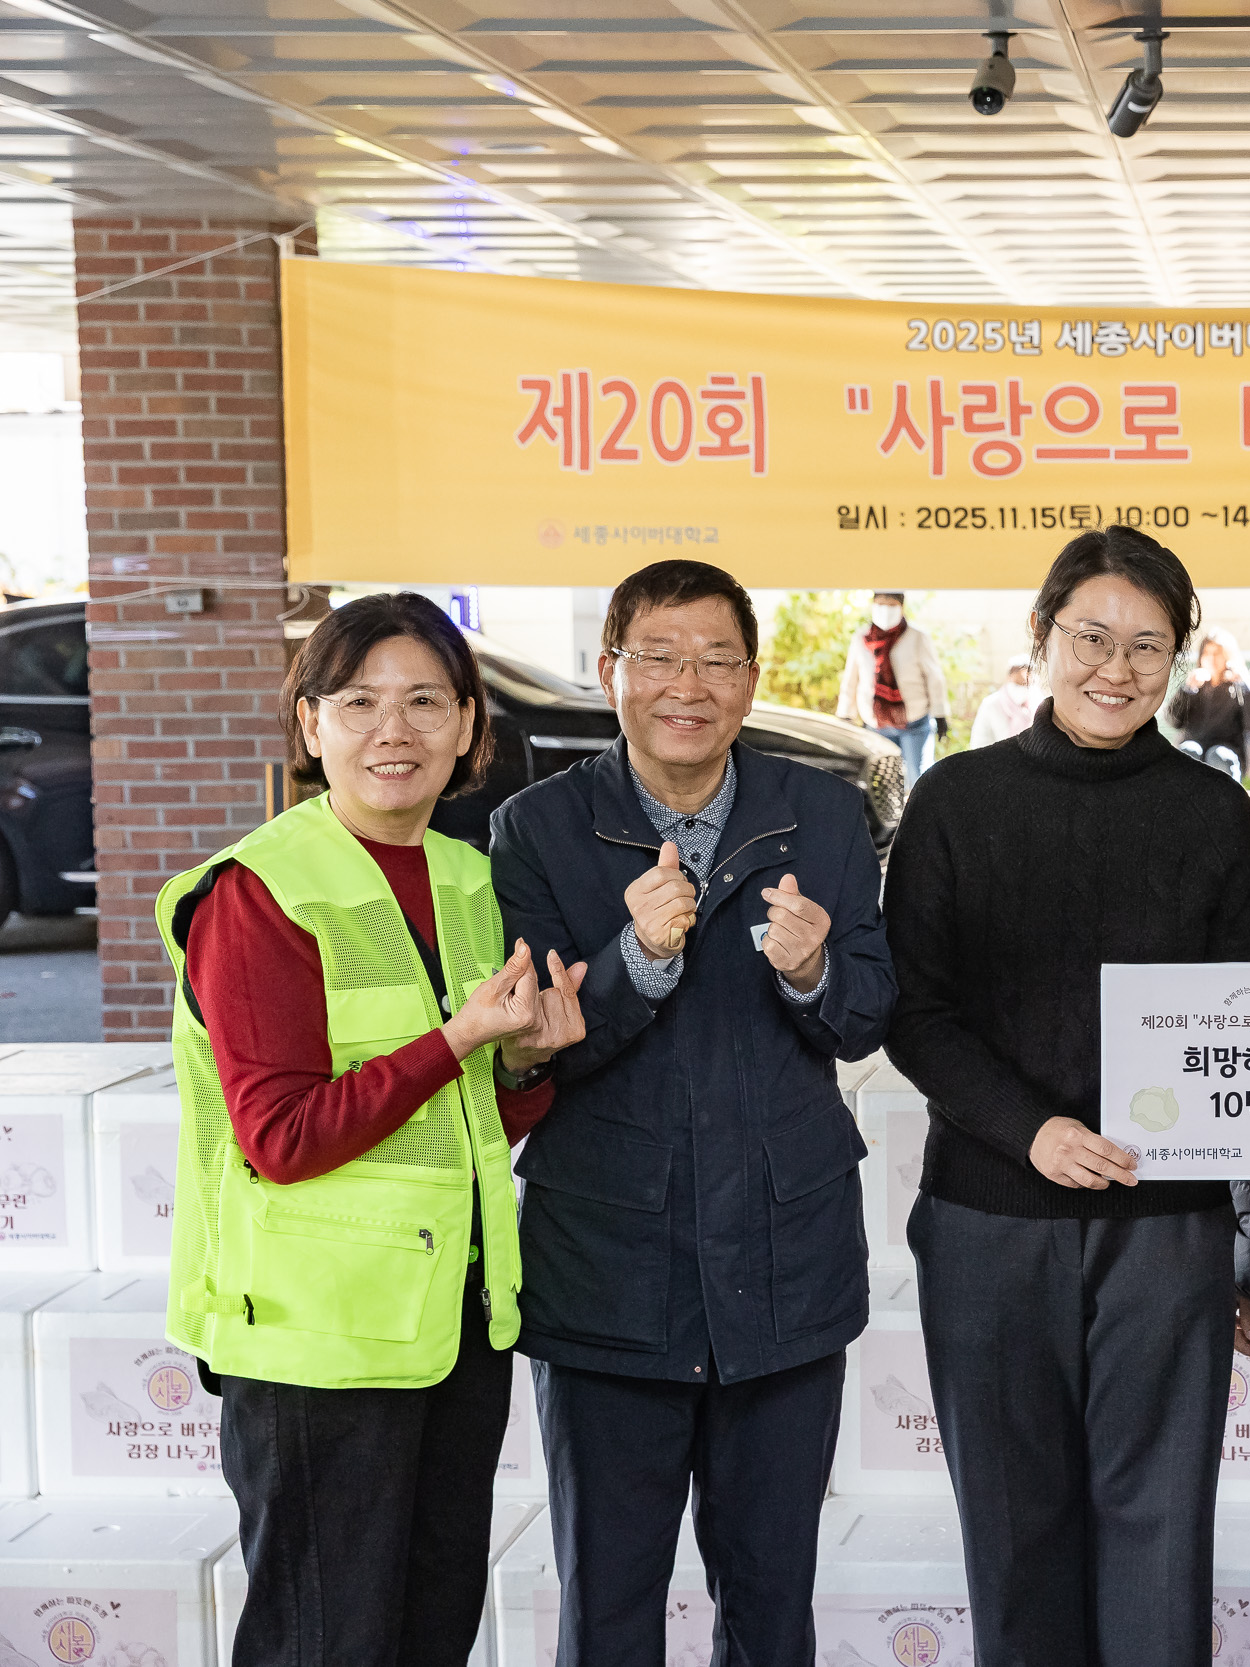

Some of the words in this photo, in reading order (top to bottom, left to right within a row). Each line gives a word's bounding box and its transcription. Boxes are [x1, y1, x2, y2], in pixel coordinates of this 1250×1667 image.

[906, 319, 1042, 355] 2025년
[516, 368, 769, 477] 제20회
[846, 377, 1192, 478] "사랑으로
[837, 504, 888, 530] 일시
[916, 504, 1101, 530] 2025.11.15(토)
[1116, 505, 1190, 529] 10:00
[574, 525, 719, 546] 세종사이버대학교
[1223, 986, 1250, 1006] 함께하는
[1141, 1014, 1188, 1029] 제20회
[1146, 1147, 1242, 1160] 세종사이버대학교
[0, 1193, 27, 1209] 무린
[106, 1421, 173, 1437] 사랑으로
[127, 1444, 159, 1459] 김장
[167, 1444, 216, 1459] 나누기
